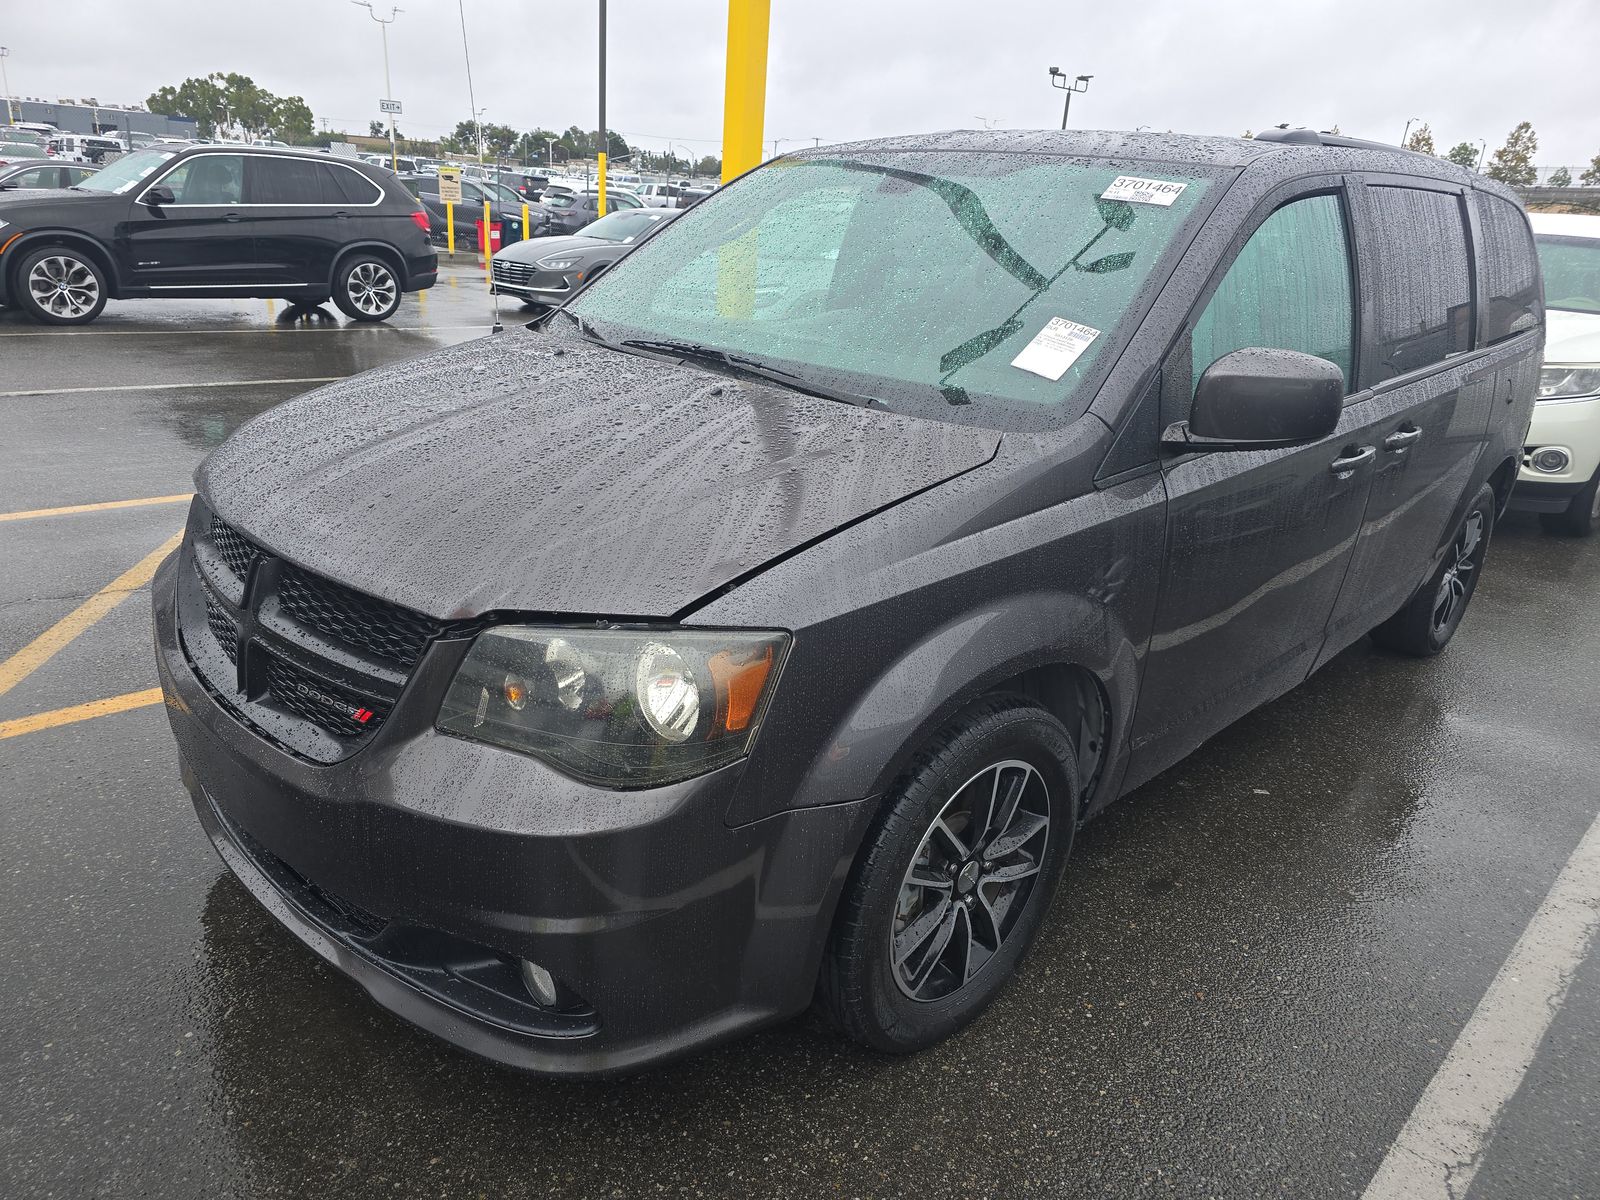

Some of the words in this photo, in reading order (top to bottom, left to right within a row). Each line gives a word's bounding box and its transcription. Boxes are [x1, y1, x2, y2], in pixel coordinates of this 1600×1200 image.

[381, 102, 396, 111] EXIT
[1113, 178, 1183, 195] 3701464
[1051, 318, 1098, 337] 3701464
[297, 683, 361, 719] DODGE
